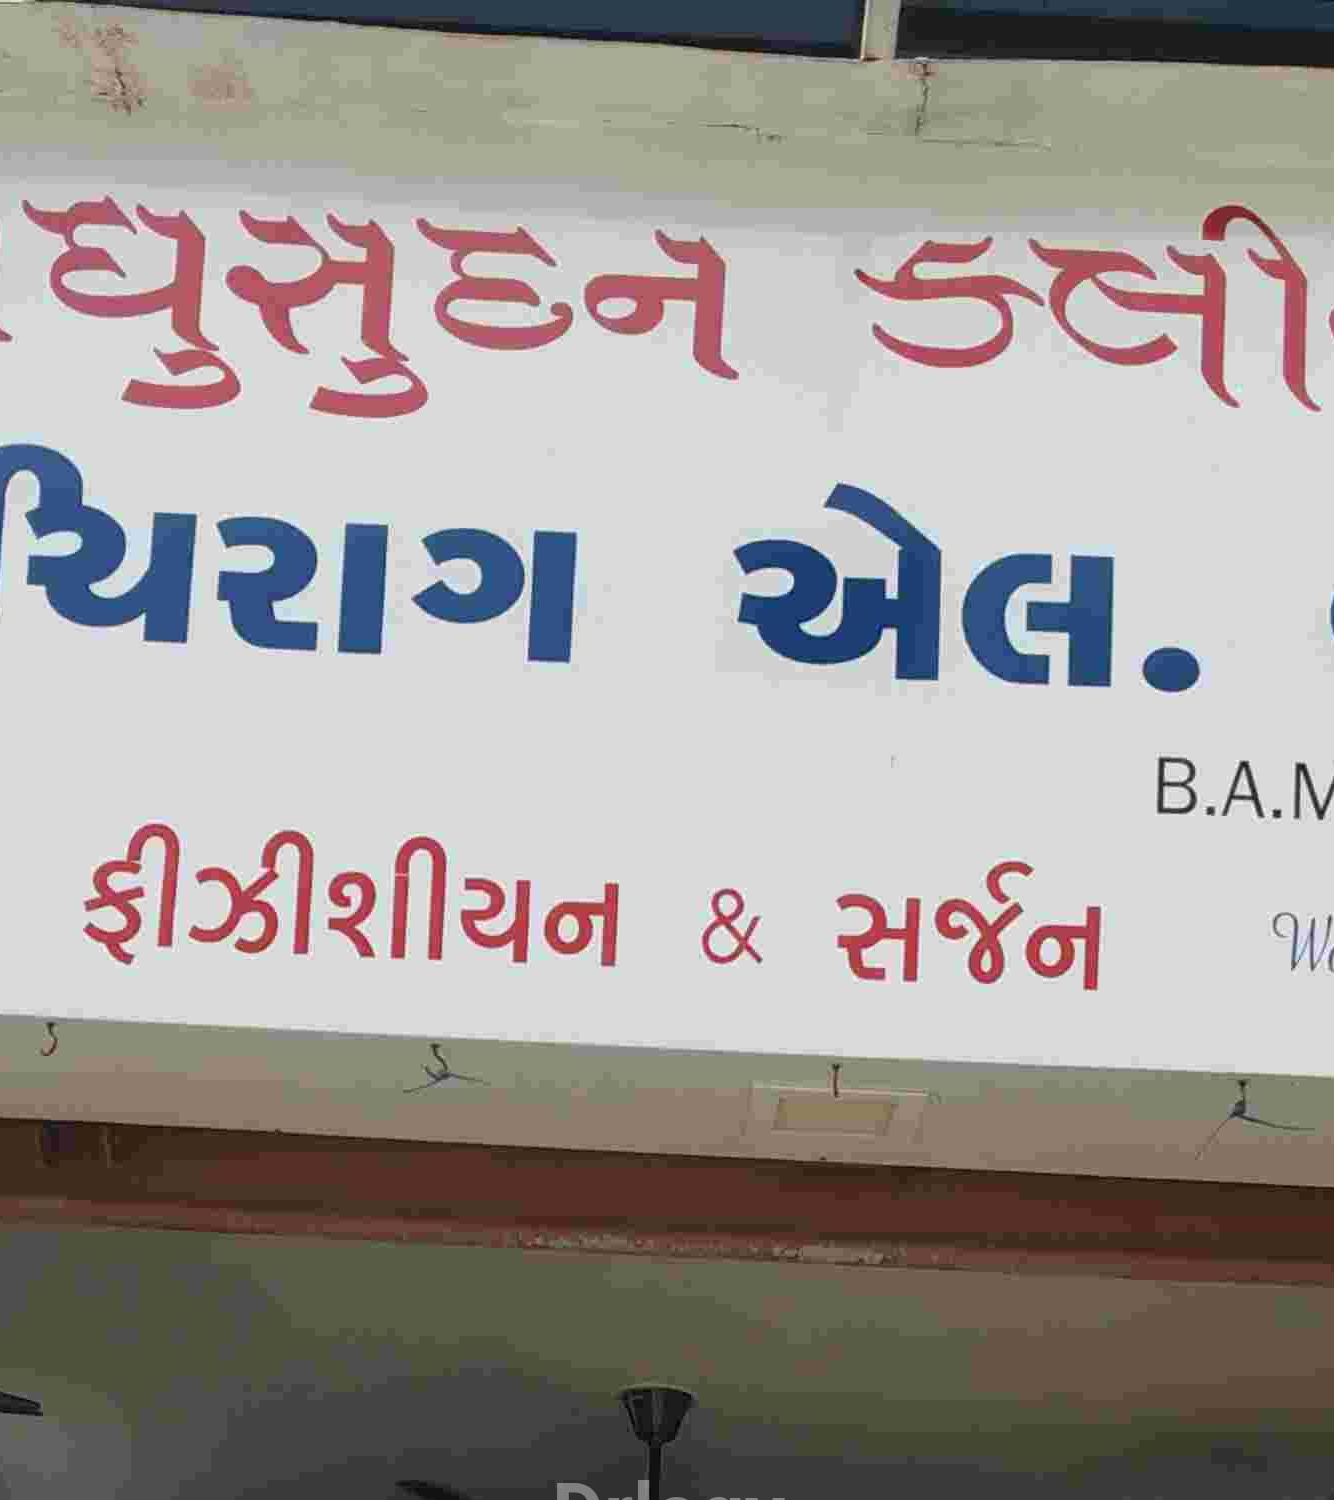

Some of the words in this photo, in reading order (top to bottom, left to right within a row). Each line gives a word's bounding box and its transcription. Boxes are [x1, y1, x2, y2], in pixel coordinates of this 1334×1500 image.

[736, 483, 1201, 693] એલ.
[80, 820, 622, 969] ફીઝીશીયન
[700, 888, 762, 964] &
[835, 860, 1102, 993] સર્જન
